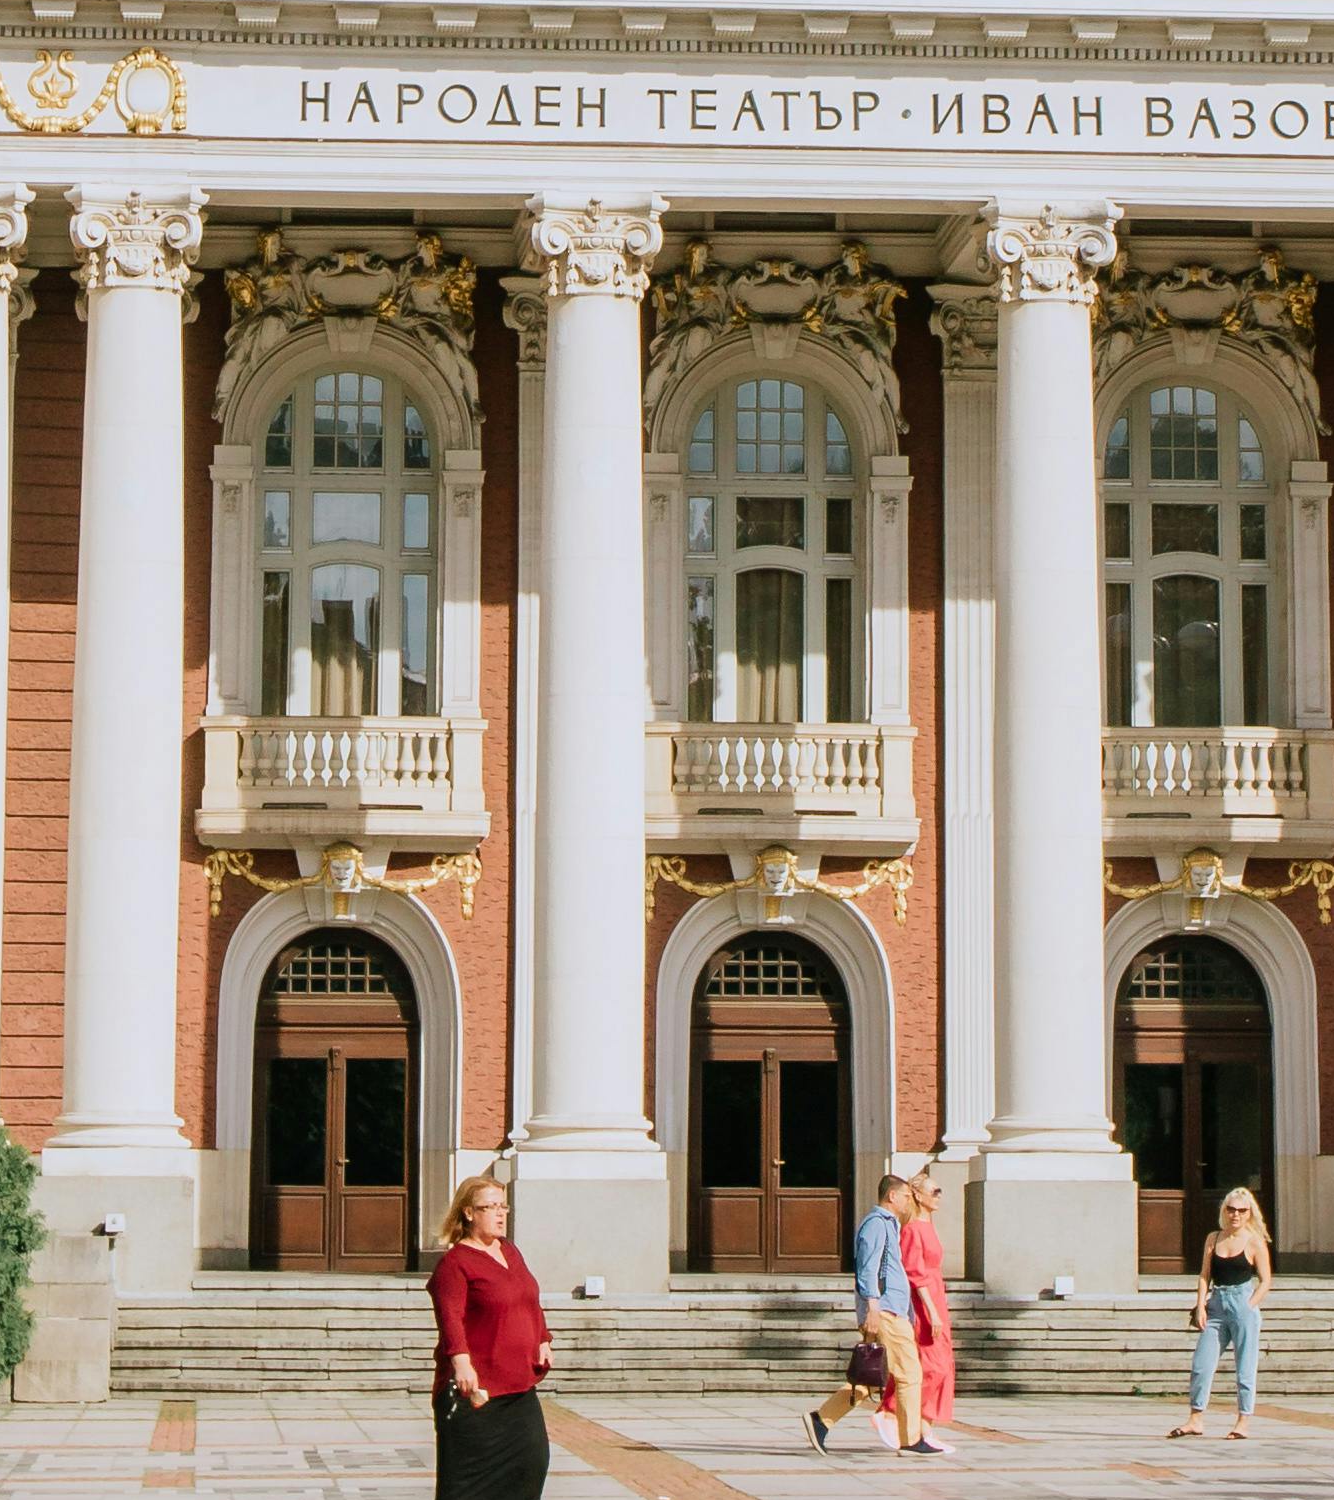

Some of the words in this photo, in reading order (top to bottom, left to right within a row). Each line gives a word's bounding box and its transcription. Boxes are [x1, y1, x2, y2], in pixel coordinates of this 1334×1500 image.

[298, 80, 607, 128] НАРОДЕН
[646, 88, 881, 132] ТЕАТЪР
[930, 91, 1104, 137] ИВАН
